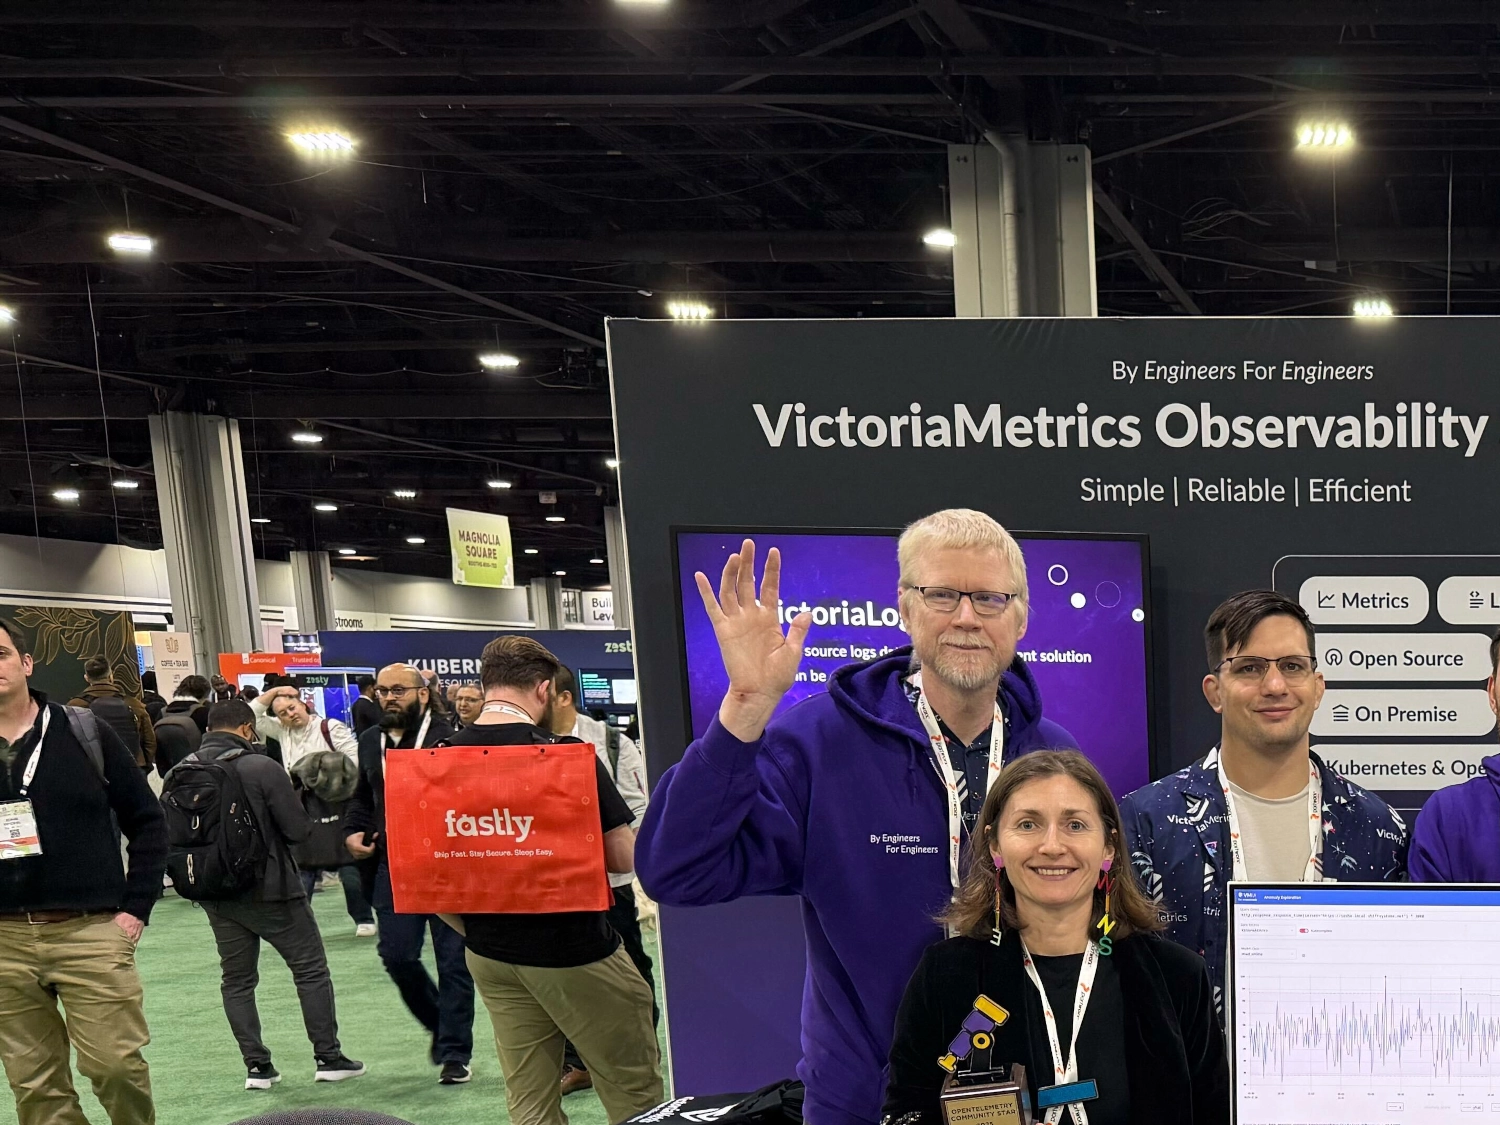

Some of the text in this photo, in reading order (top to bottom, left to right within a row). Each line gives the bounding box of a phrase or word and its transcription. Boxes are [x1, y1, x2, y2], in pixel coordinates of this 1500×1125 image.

[1112, 360, 1374, 384] By Engineers For Engineers
[752, 402, 1141, 449] VictoriaMetrics
[1155, 401, 1489, 457] Observability
[1080, 477, 1165, 507] Simple
[1188, 477, 1286, 502] Reliable
[1309, 477, 1412, 503] Efficient
[458, 529, 501, 547] MAGNOLIA
[465, 545, 498, 560] SQUARE
[1342, 592, 1409, 609] Metrics
[605, 640, 633, 653] zest
[804, 645, 877, 661] source logs
[250, 656, 276, 664] Canonical
[292, 656, 312, 664] Trusted
[1040, 650, 1092, 664] solution
[1348, 650, 1464, 671] Open Source
[306, 674, 329, 686] zesty
[811, 670, 827, 683] be
[1355, 705, 1458, 722] On Premise
[1326, 758, 1427, 777] Kubernetes
[1431, 759, 1445, 776] &
[444, 807, 534, 843] fastly
[870, 833, 921, 845] By Engineers
[434, 851, 450, 859] Ship
[469, 850, 485, 859] Stay
[514, 849, 534, 857] Sleep
[886, 844, 939, 856] For Engineers
[950, 1108, 1016, 1121] COMMUNITY STAR
[951, 1102, 1013, 1115] OPENTELEMETRY
